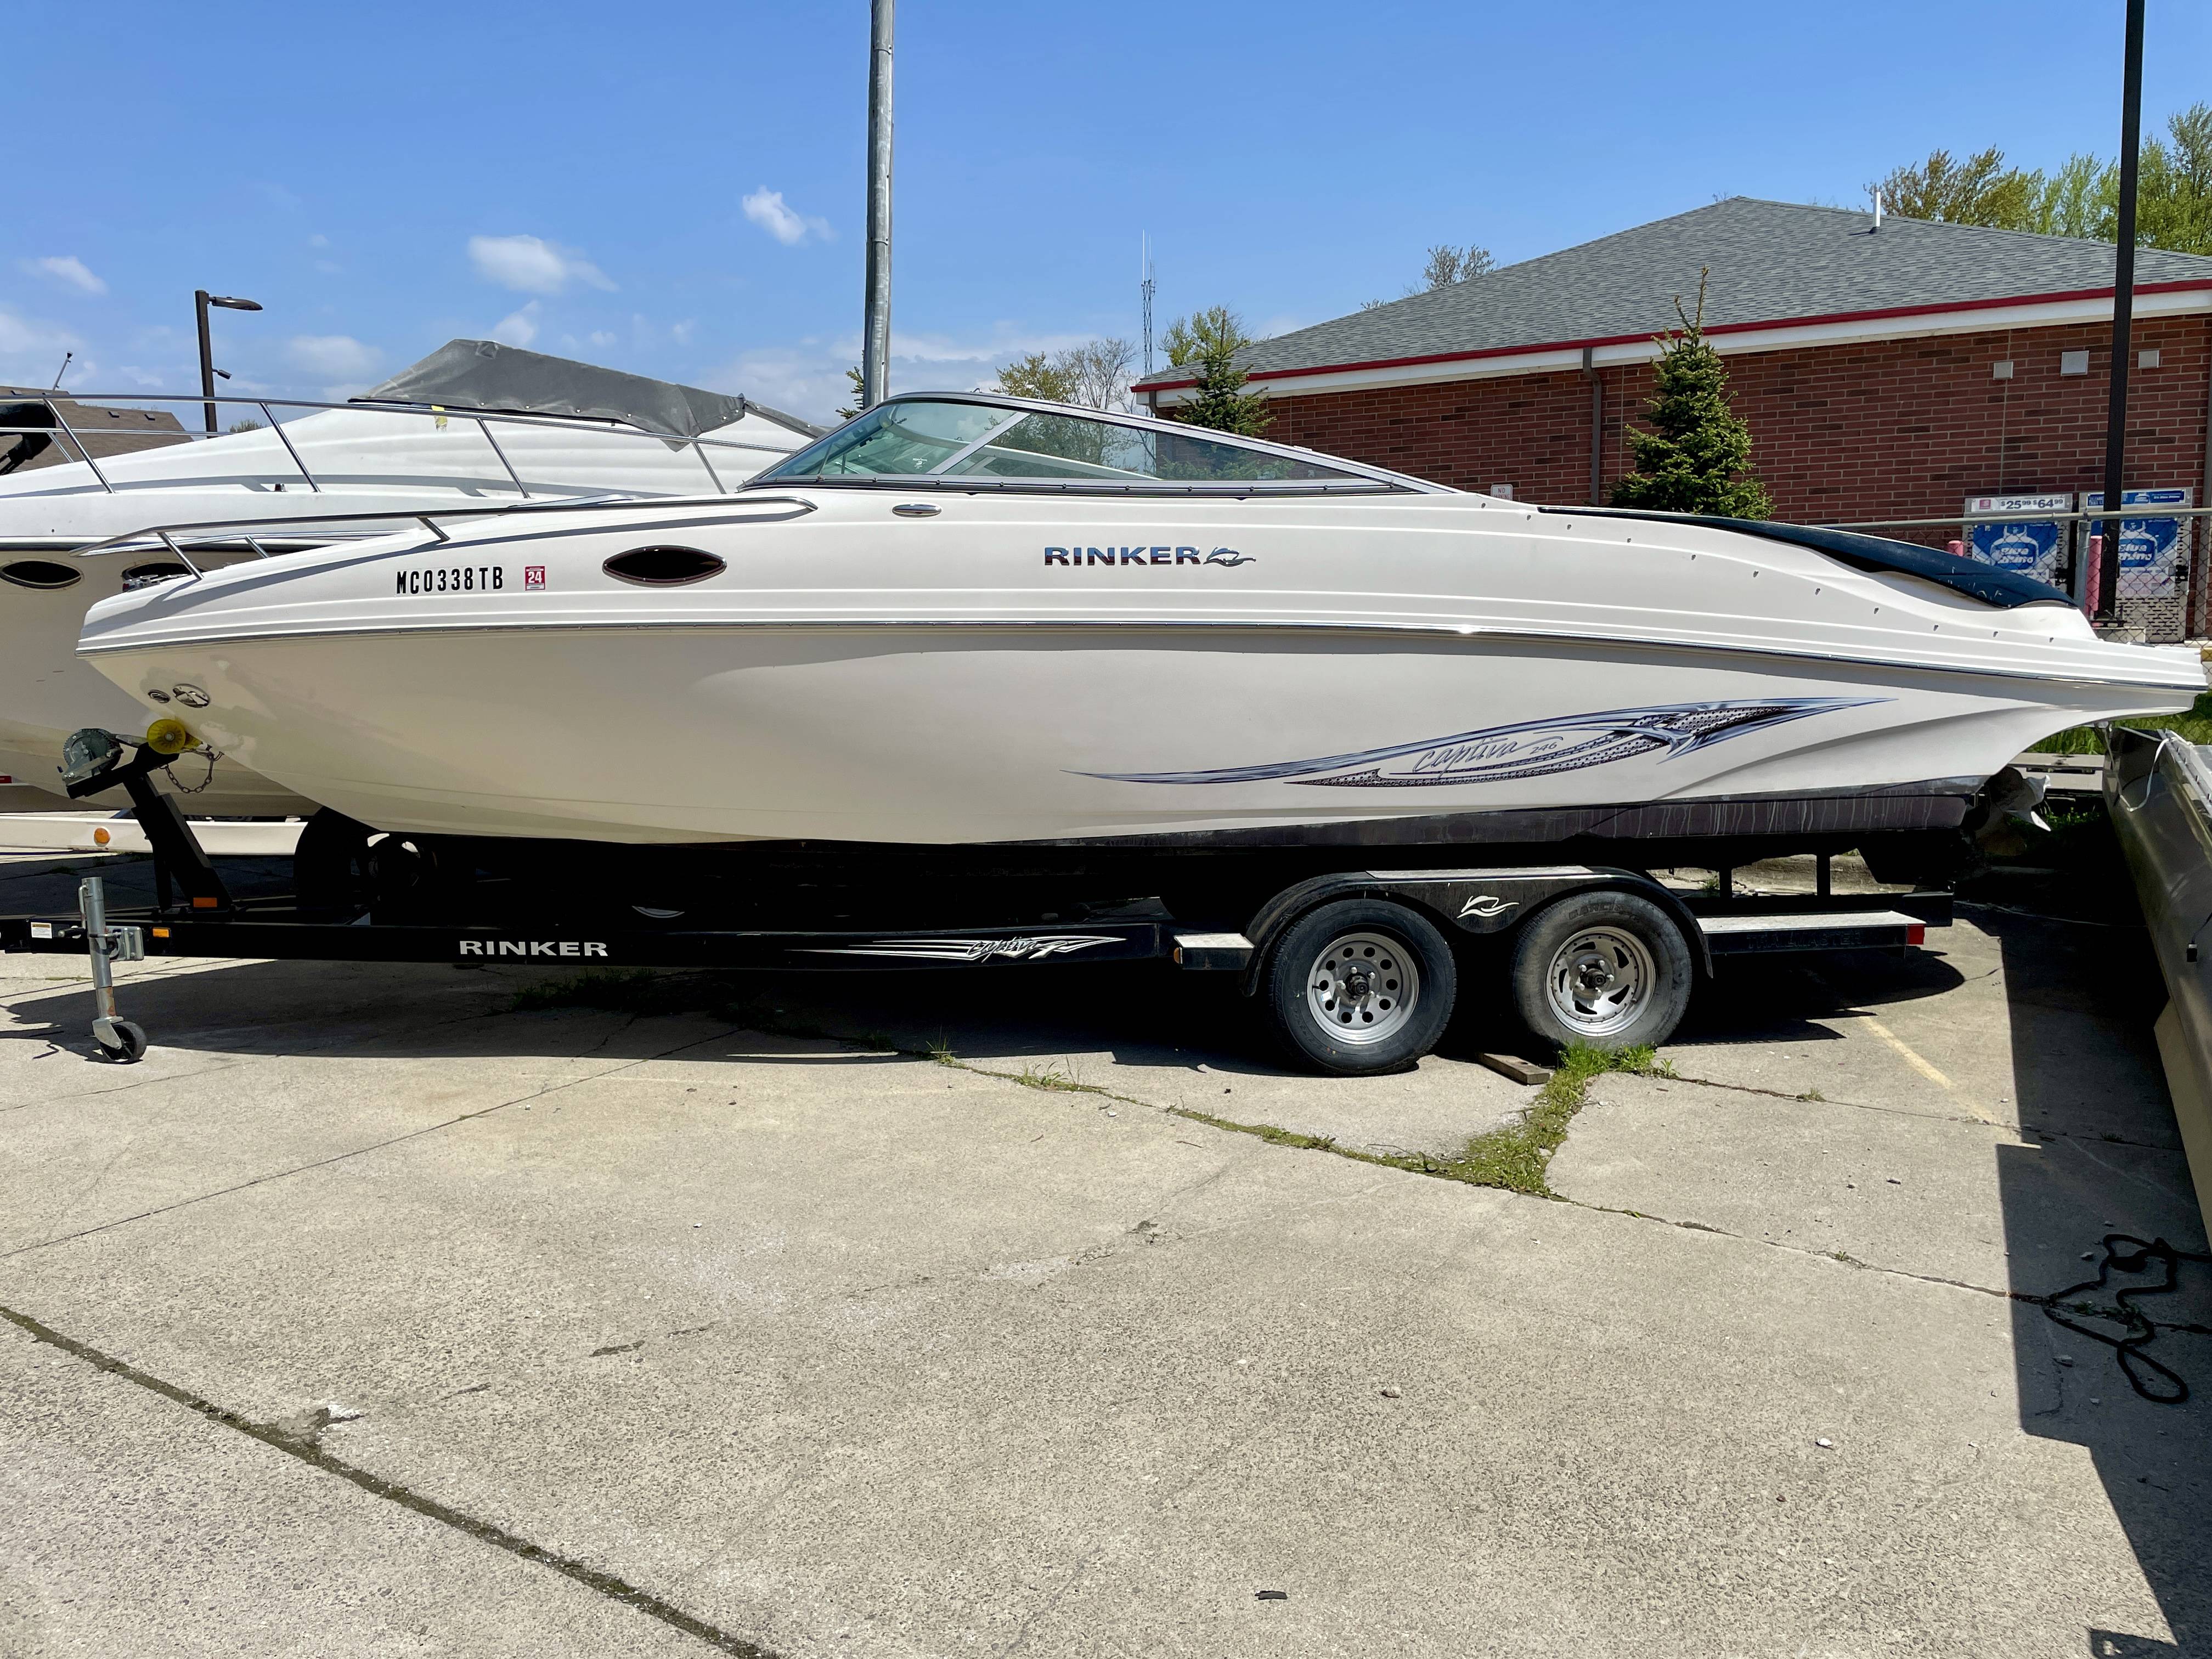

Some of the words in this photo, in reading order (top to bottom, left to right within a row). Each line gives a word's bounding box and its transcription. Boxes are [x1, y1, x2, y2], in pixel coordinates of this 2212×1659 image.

[1045, 546, 1201, 566] RINKER
[528, 571, 542, 583] 24
[1530, 742, 1557, 754] 246
[459, 940, 608, 957] RINKER
